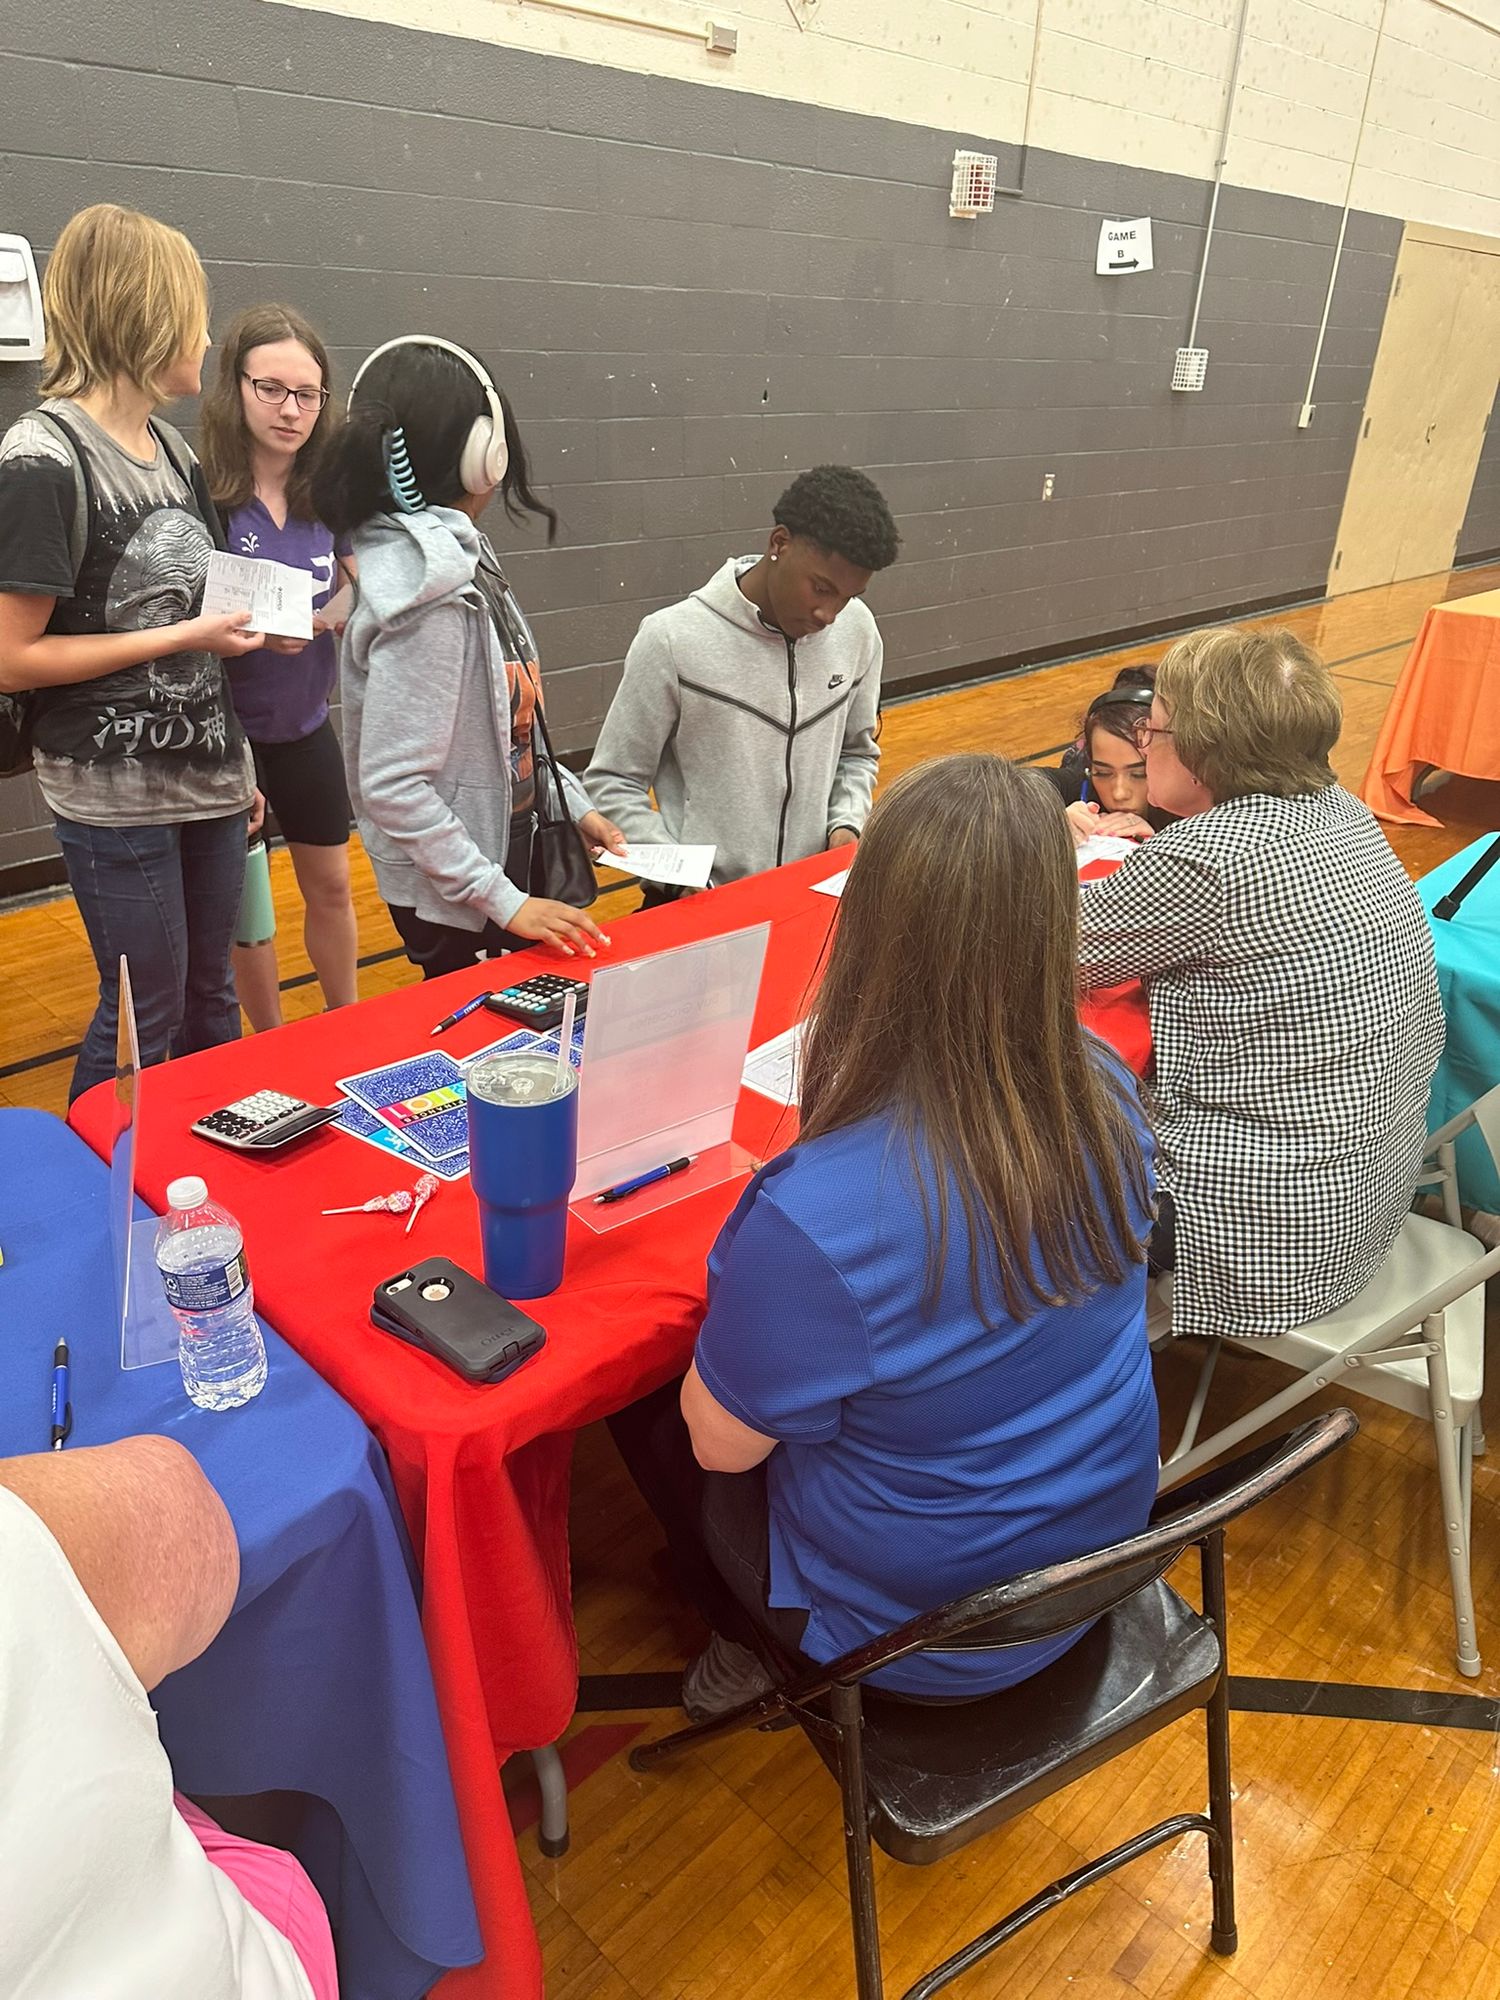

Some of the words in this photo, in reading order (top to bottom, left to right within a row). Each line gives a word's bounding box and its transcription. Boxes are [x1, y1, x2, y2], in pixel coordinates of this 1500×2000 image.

[1108, 230, 1137, 241] GAME
[1117, 249, 1125, 258] B
[93, 703, 227, 758] 河の神
[403, 1099, 465, 1123] FINANCES
